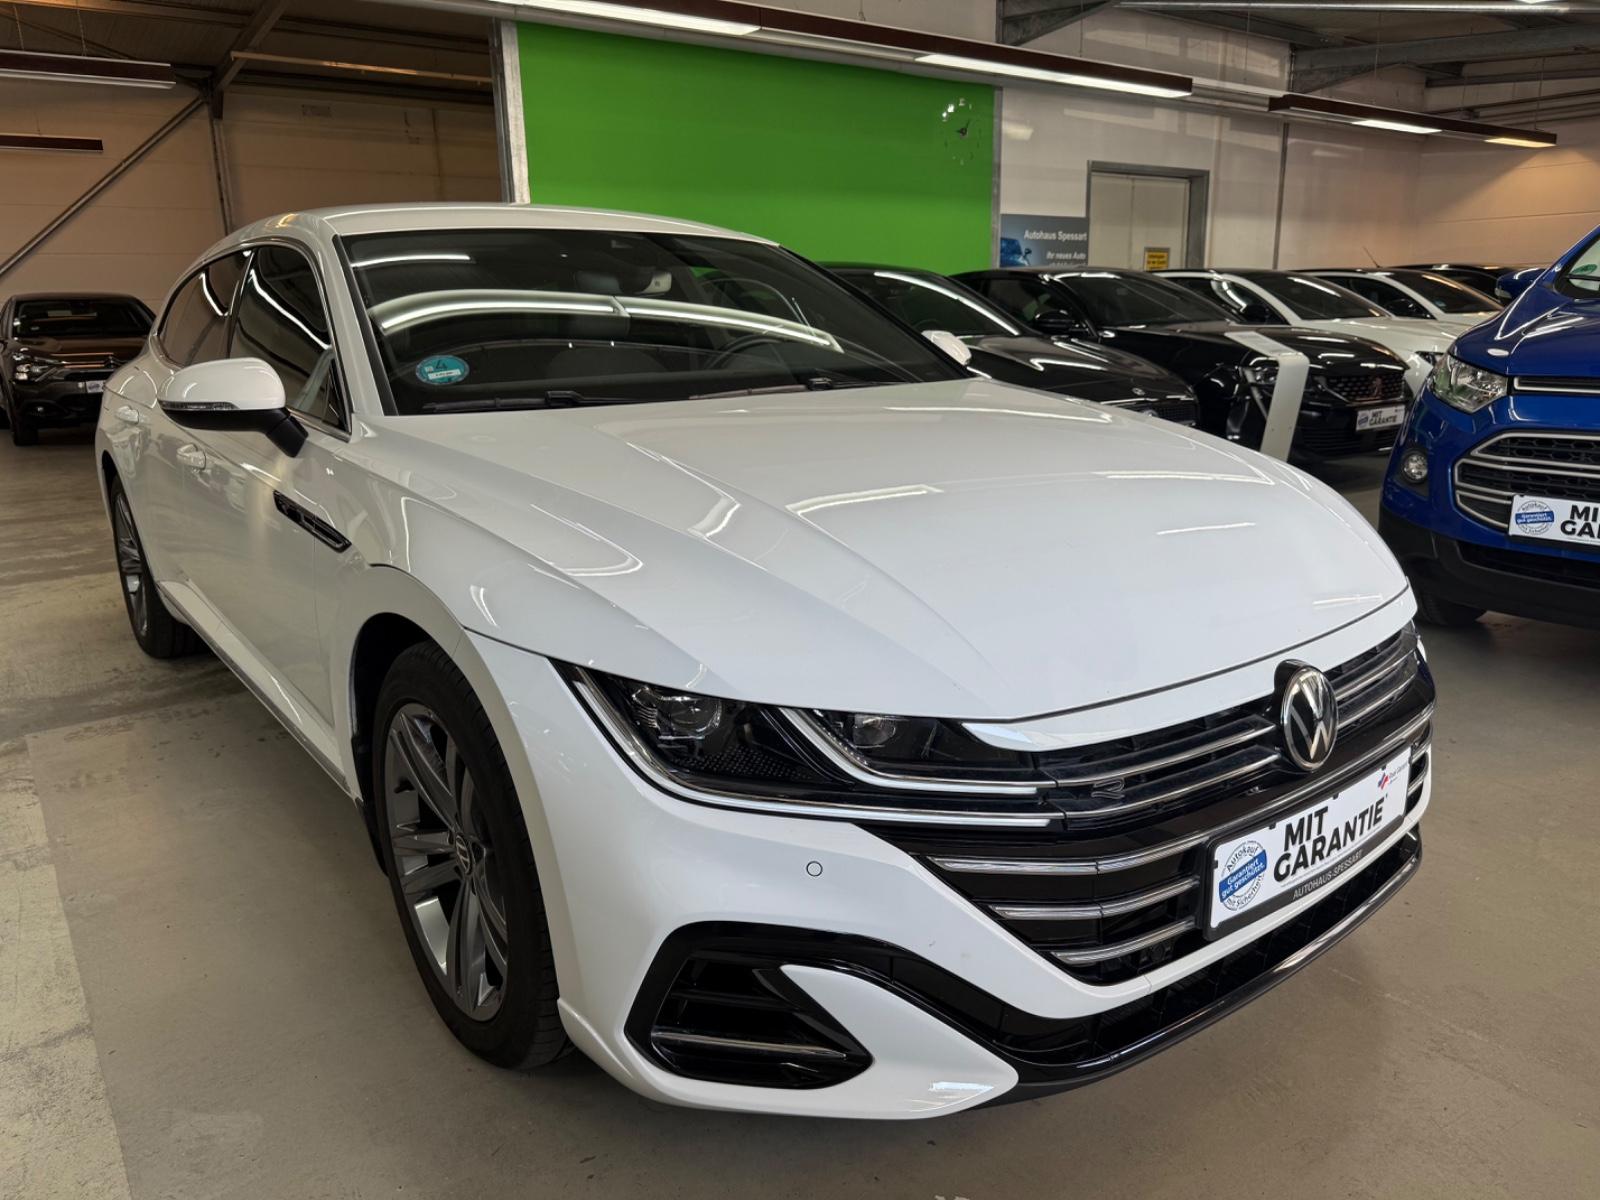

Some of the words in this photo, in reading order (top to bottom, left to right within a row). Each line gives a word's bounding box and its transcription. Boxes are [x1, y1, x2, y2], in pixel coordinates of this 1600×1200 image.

[1024, 229, 1056, 240] Autohaus
[1058, 230, 1087, 242] Spessart
[1056, 252, 1072, 260] neues
[1073, 251, 1086, 260] Auto
[1274, 796, 1385, 882] GARANTIE
[1284, 806, 1329, 852] MIT
[1227, 858, 1259, 885] Garantiert
[1221, 884, 1234, 899] gut
